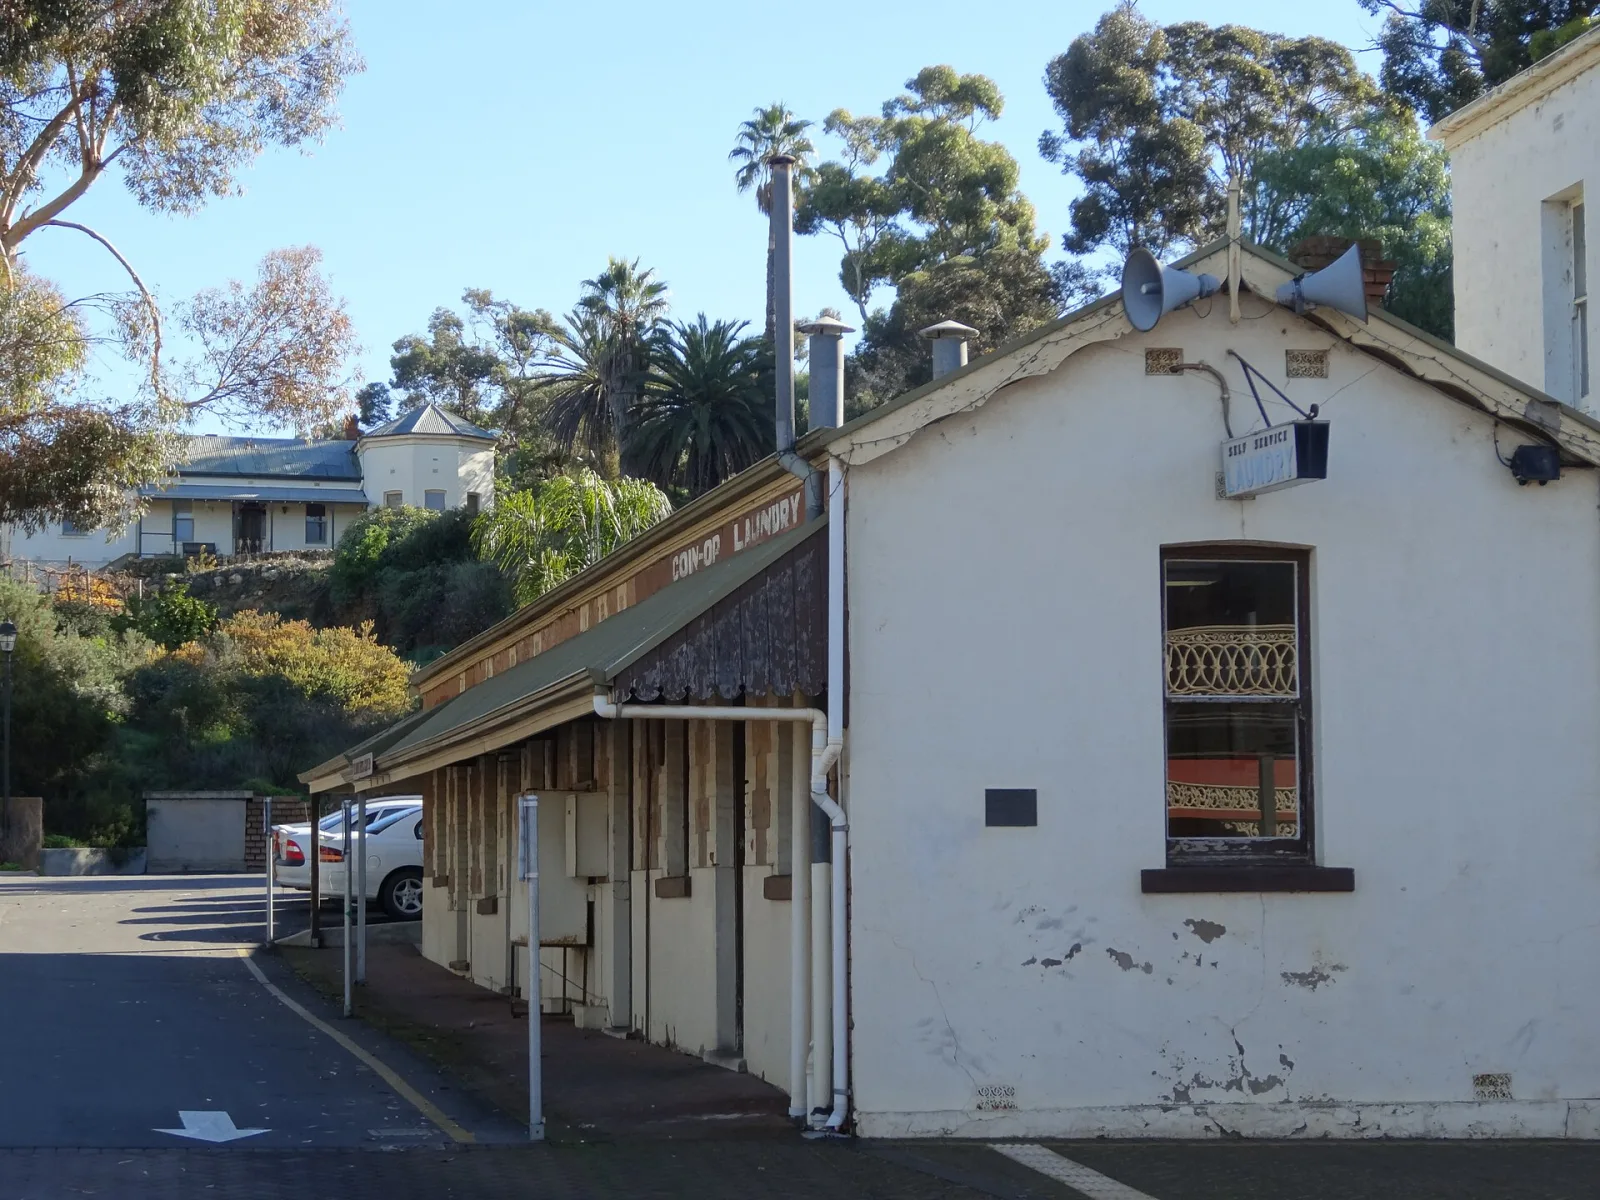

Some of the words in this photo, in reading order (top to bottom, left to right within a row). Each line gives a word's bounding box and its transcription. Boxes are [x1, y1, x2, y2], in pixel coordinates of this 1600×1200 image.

[1228, 442, 1247, 457] SELF
[1254, 430, 1288, 450] SERVICE
[1226, 445, 1294, 494] LAUNDRY
[672, 534, 720, 582] COIN-OP
[733, 491, 801, 552] LAUNDRY
